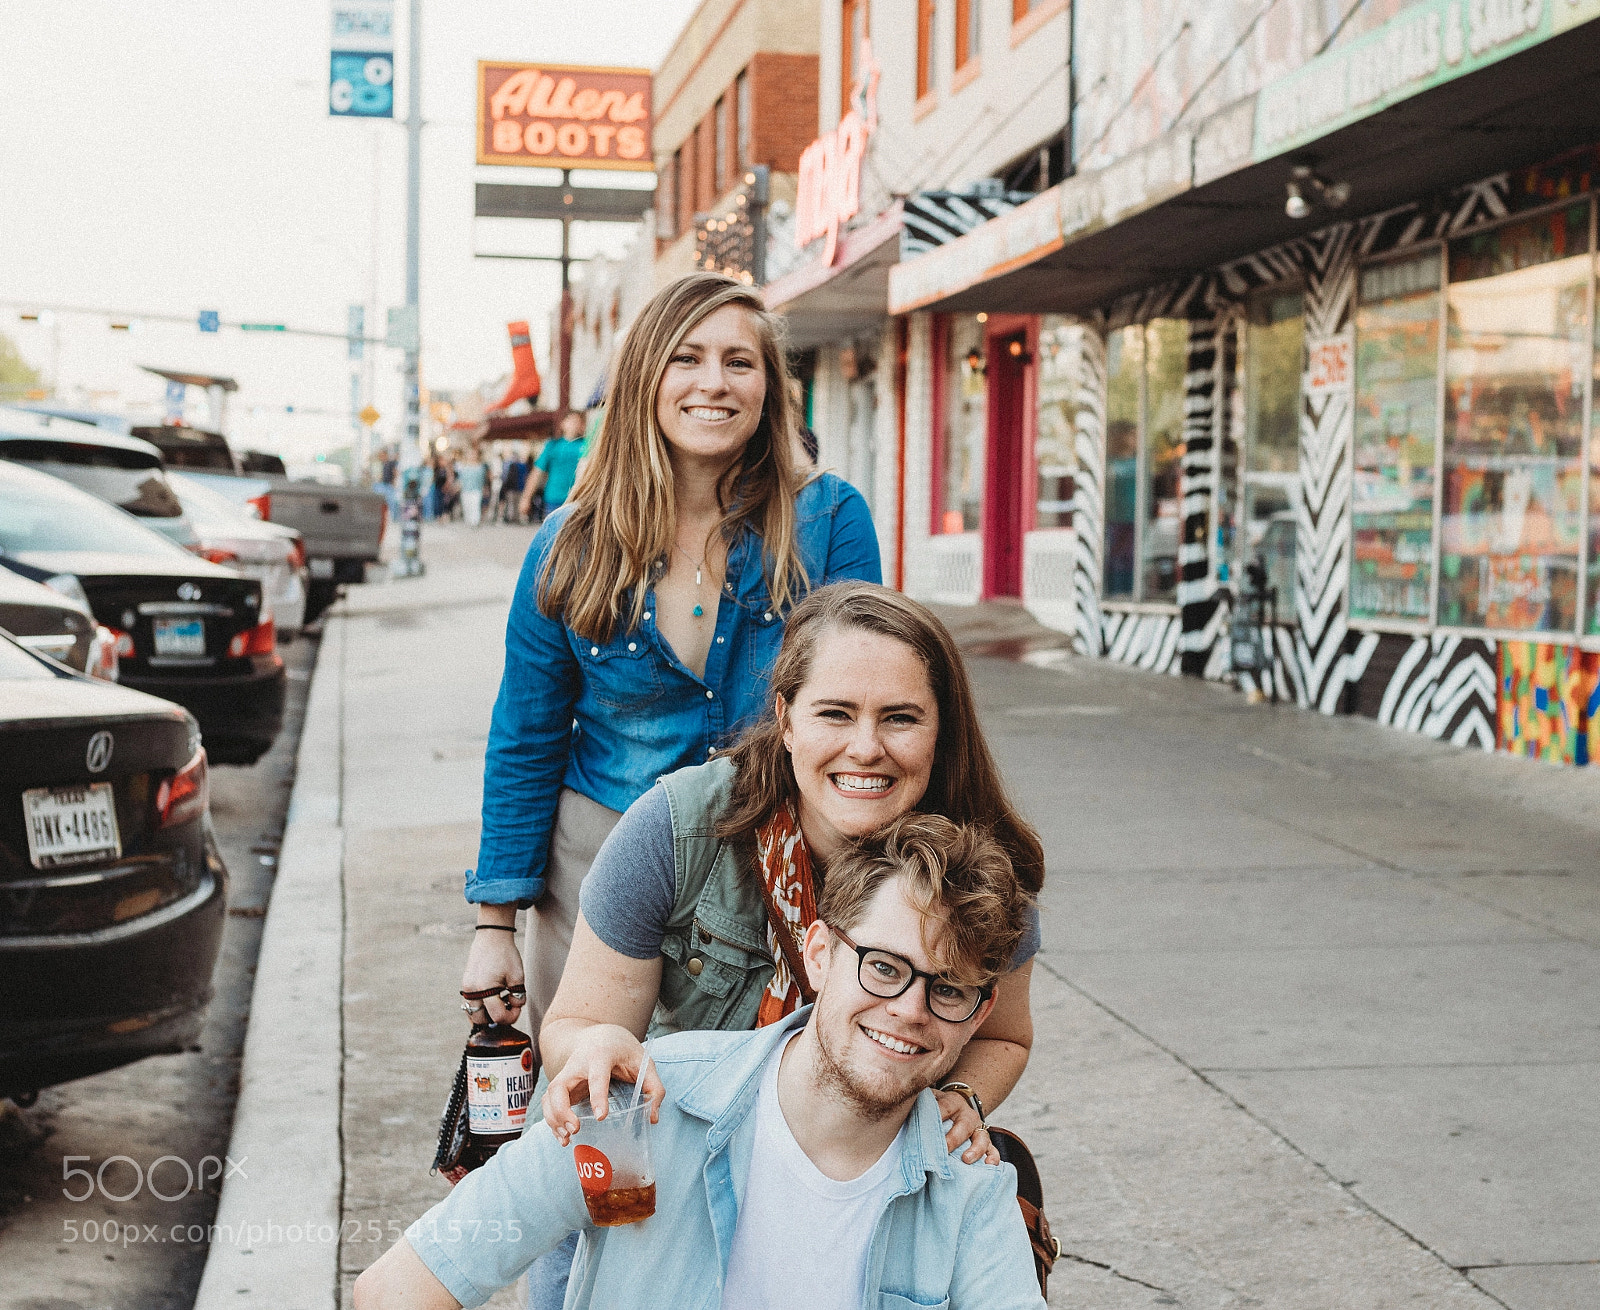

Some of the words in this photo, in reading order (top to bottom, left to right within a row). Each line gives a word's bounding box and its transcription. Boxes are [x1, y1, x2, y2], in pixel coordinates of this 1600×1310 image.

[490, 69, 648, 122] Allens
[493, 120, 645, 159] BOOTS
[578, 1161, 605, 1179] JO'S
